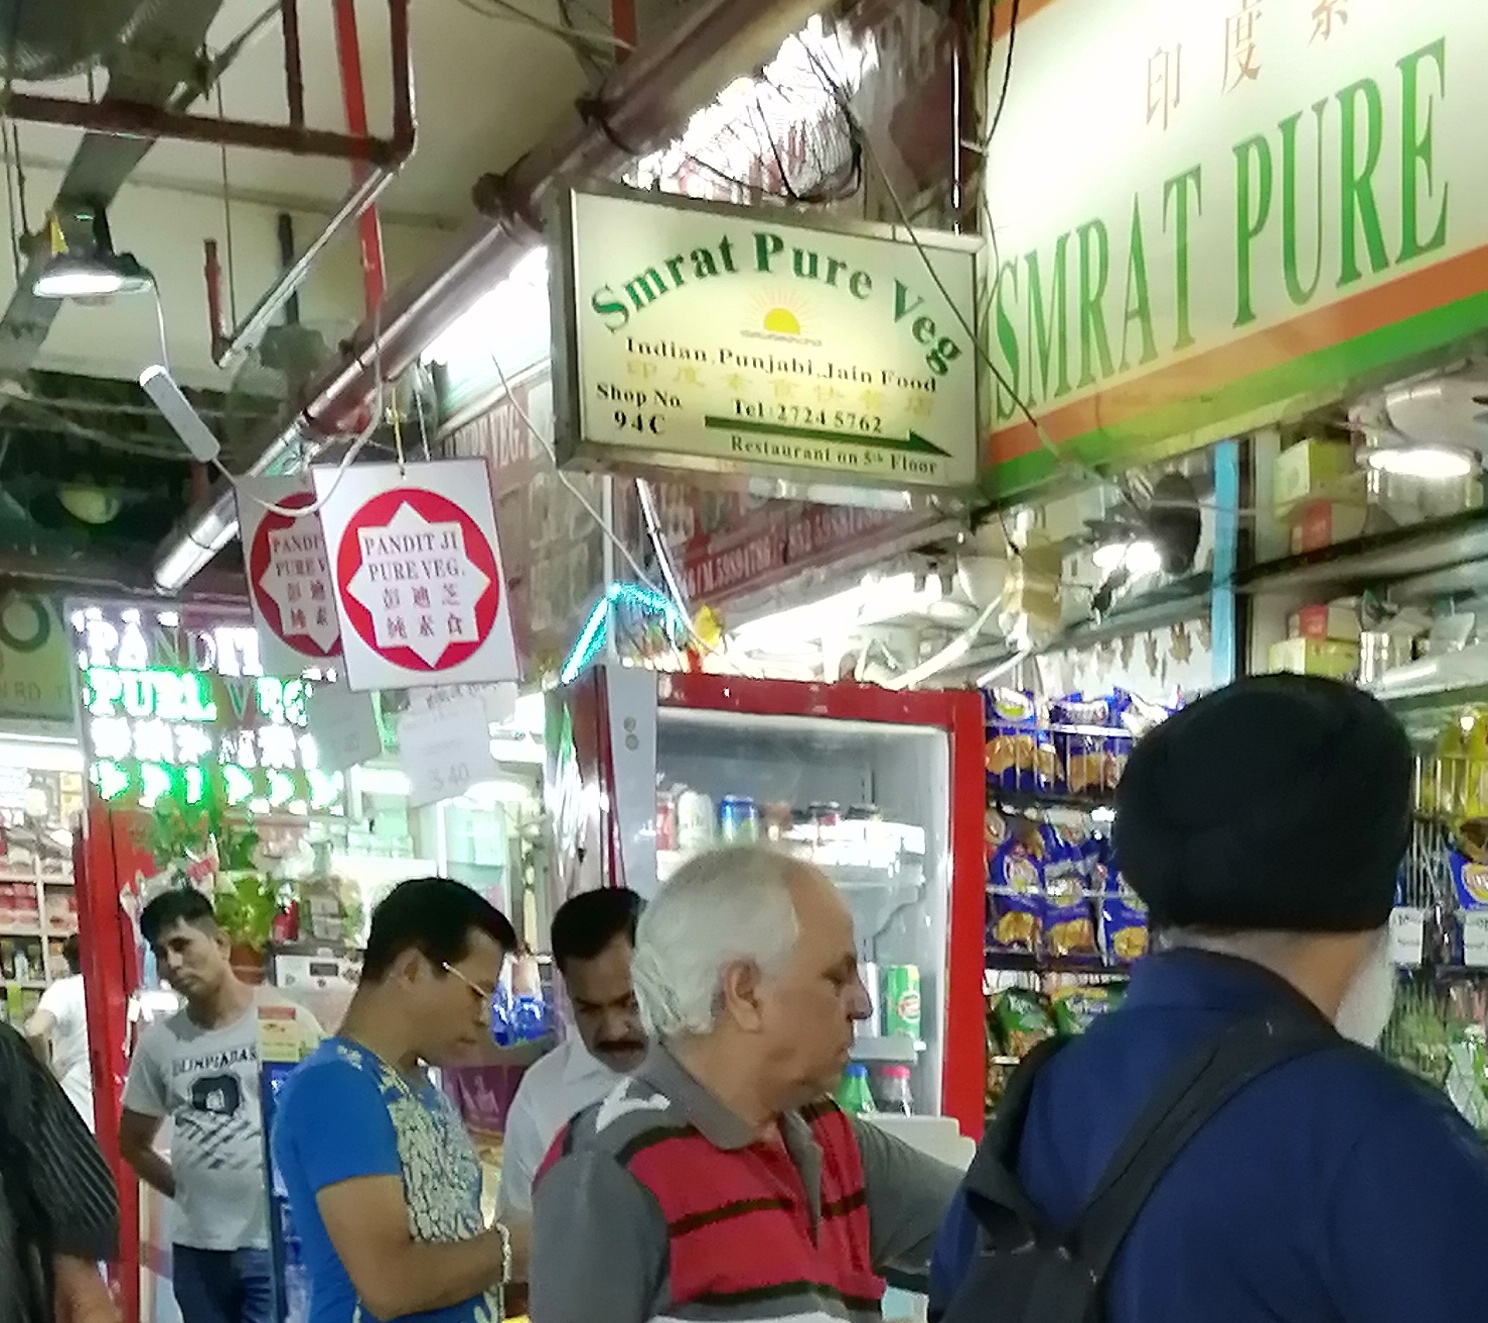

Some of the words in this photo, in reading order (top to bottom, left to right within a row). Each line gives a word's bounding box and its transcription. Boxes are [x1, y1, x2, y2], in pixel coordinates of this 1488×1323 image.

[993, 163, 1202, 420] SMRAT
[1232, 38, 1449, 327] PURE
[592, 233, 738, 334] Smrat
[753, 233, 875, 300] Pure
[893, 279, 962, 377] Veg
[881, 370, 937, 393] Food
[596, 382, 647, 408] Shop
[614, 410, 668, 435] 94C
[834, 410, 882, 434] 5762
[731, 435, 830, 463] Restaurant
[837, 451, 858, 466] on
[891, 453, 937, 475] Floor
[272, 535, 321, 553] PANDI
[364, 532, 435, 556] PANDIT
[440, 531, 458, 550] JI
[369, 562, 419, 582] PURE
[420, 558, 466, 579] VEG.
